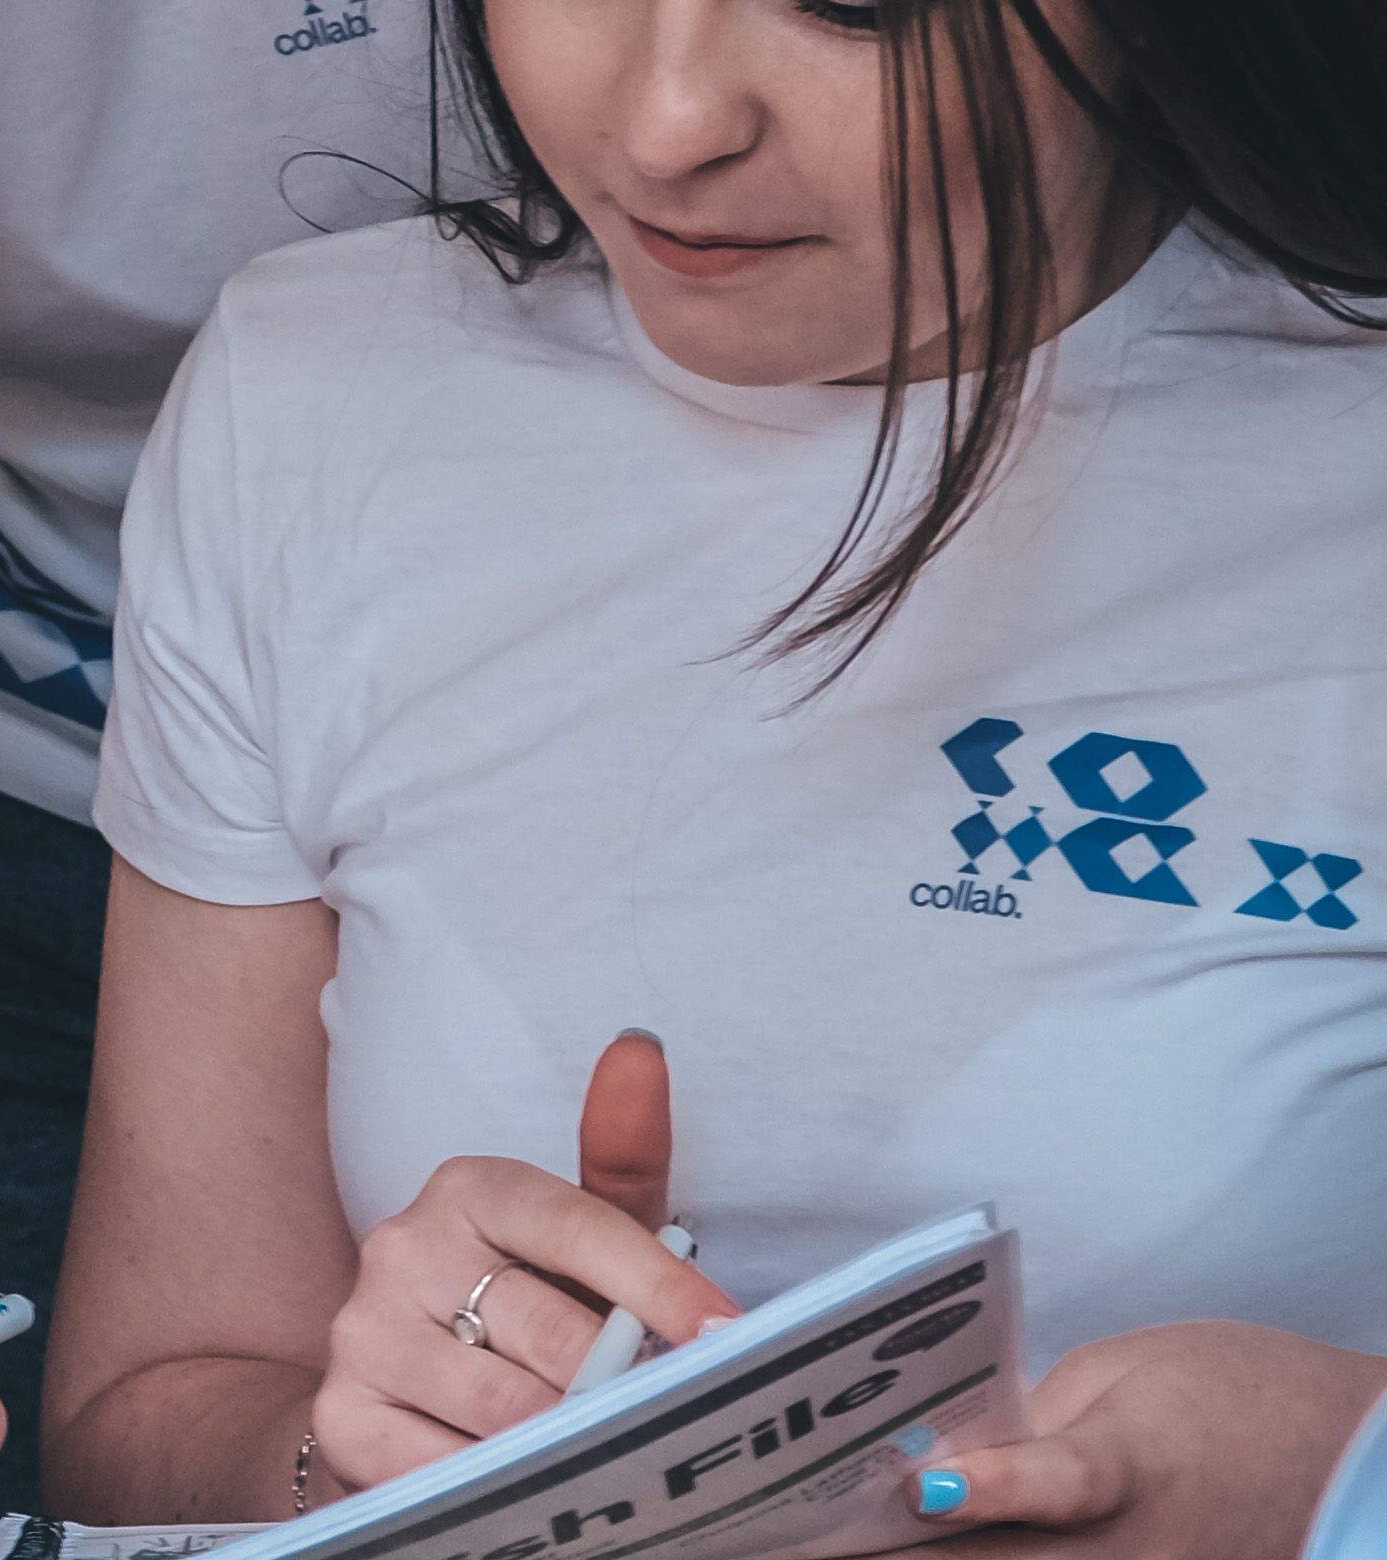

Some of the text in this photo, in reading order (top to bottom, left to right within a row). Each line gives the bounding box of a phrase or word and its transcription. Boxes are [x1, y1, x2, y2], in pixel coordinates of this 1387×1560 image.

[274, 11, 378, 56] collab.
[910, 879, 1023, 920] collab.
[662, 1368, 903, 1503] File
